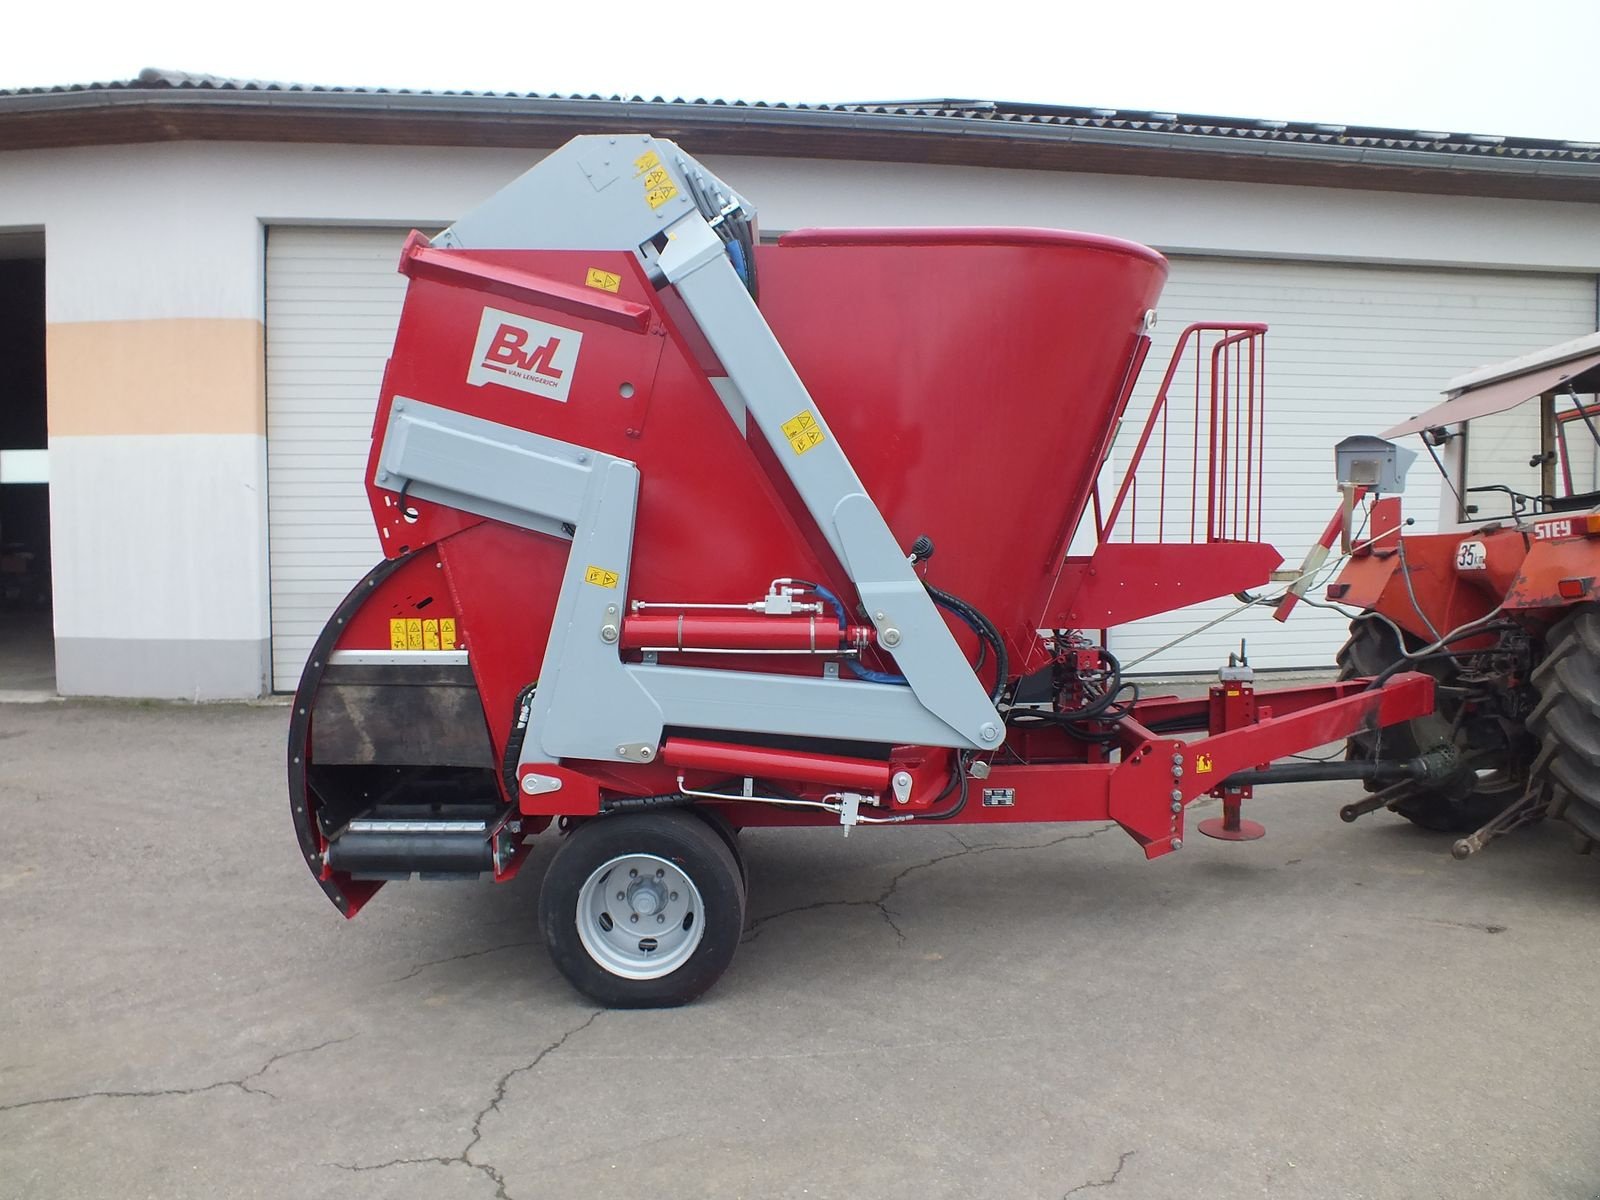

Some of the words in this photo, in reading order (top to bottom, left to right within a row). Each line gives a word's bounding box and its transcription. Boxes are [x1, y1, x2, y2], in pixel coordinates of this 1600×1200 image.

[508, 370, 522, 378] VAN
[523, 374, 558, 387] LENGERICH
[1459, 544, 1476, 566] 35
